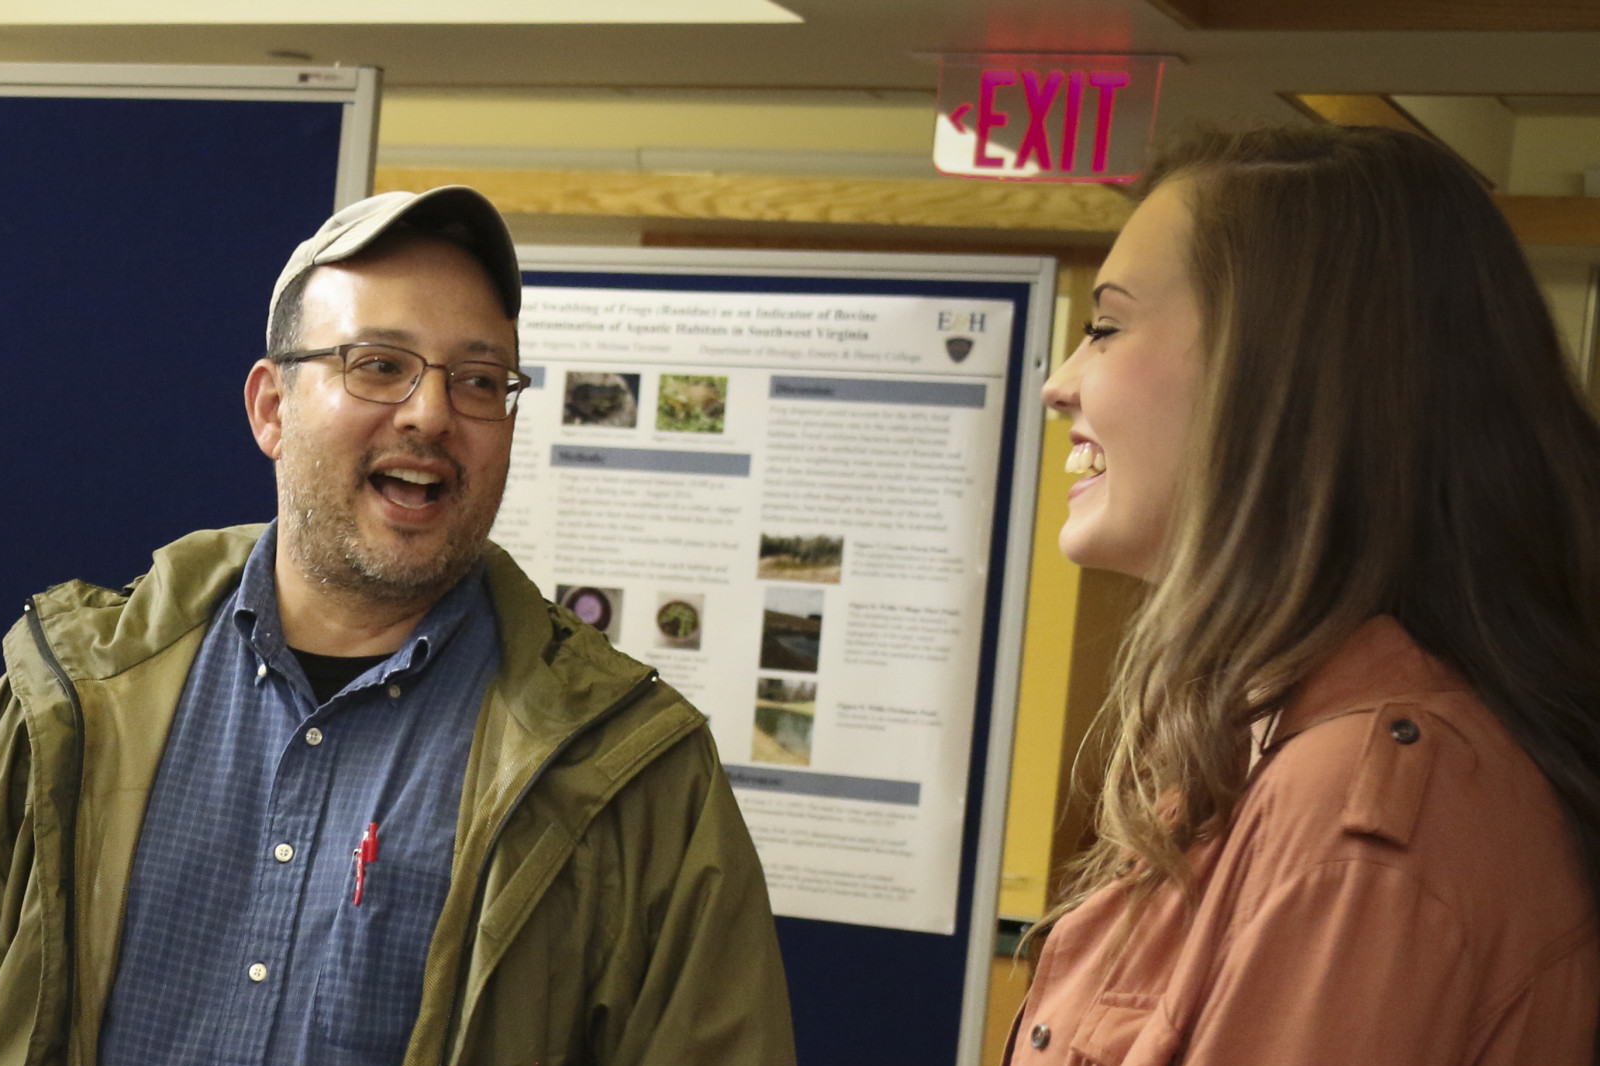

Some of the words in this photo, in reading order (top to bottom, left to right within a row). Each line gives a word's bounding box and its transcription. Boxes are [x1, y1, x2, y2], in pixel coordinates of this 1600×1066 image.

[974, 69, 1130, 173] EXIT
[604, 303, 615, 313] of
[818, 310, 830, 320] of
[609, 321, 622, 332] of
[748, 326, 812, 339] Southwest
[816, 328, 869, 342] Virginia
